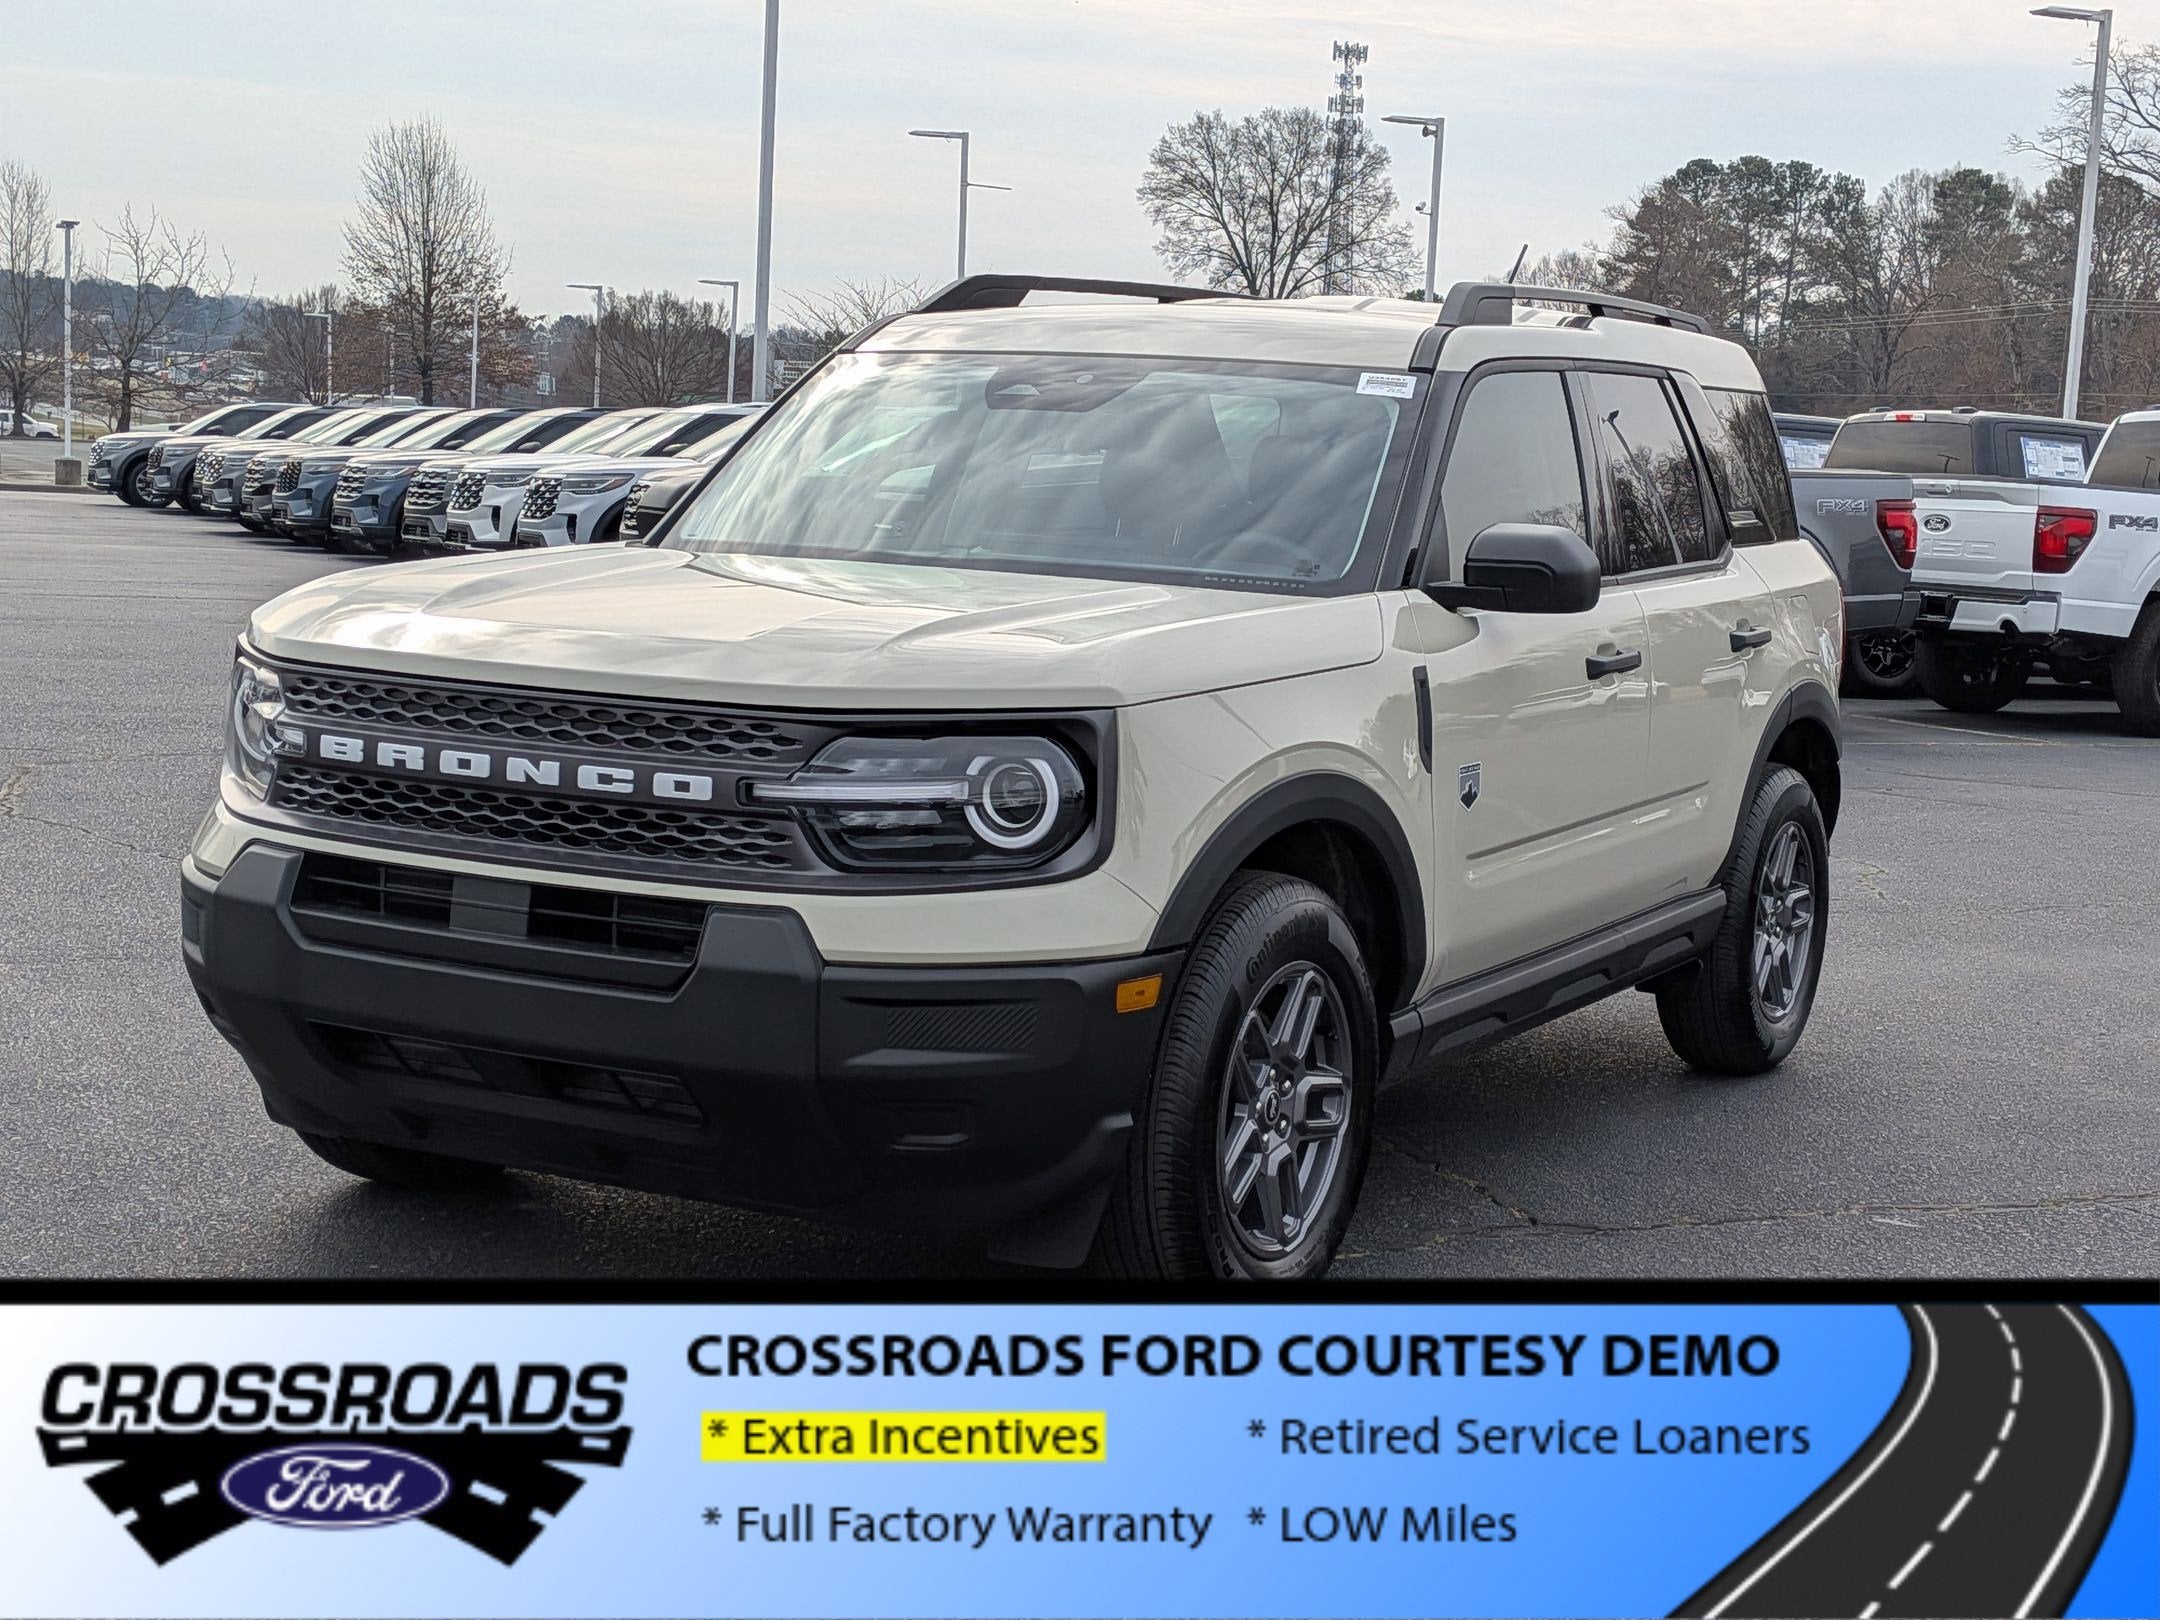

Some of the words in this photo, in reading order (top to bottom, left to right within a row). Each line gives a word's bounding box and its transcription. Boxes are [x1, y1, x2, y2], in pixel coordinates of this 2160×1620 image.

[1816, 499, 1868, 515] FX4
[2108, 514, 2158, 530] FX4
[319, 734, 713, 801] BRONCO
